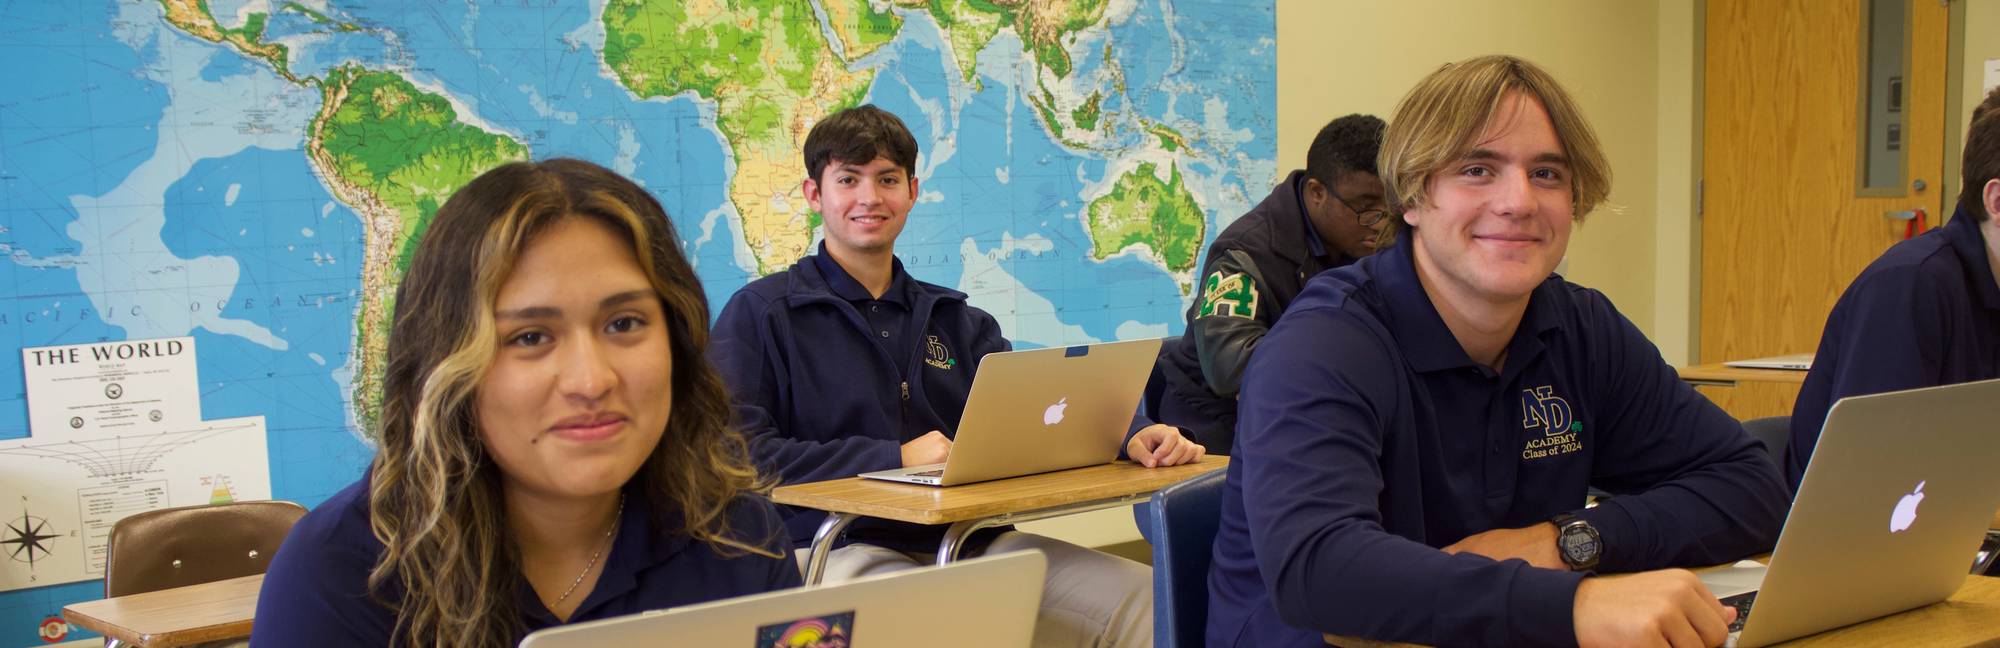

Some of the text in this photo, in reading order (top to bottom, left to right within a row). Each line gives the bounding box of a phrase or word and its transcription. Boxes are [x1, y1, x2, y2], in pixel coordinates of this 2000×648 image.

[910, 250, 1061, 265] DIAN OCEAN
[190, 295, 308, 313] OCEAN
[32, 340, 183, 367] THE WORLD
[1522, 385, 1572, 435] ND
[1525, 433, 1577, 449] ACADEMY
[1523, 442, 1582, 459] Class of 2024
